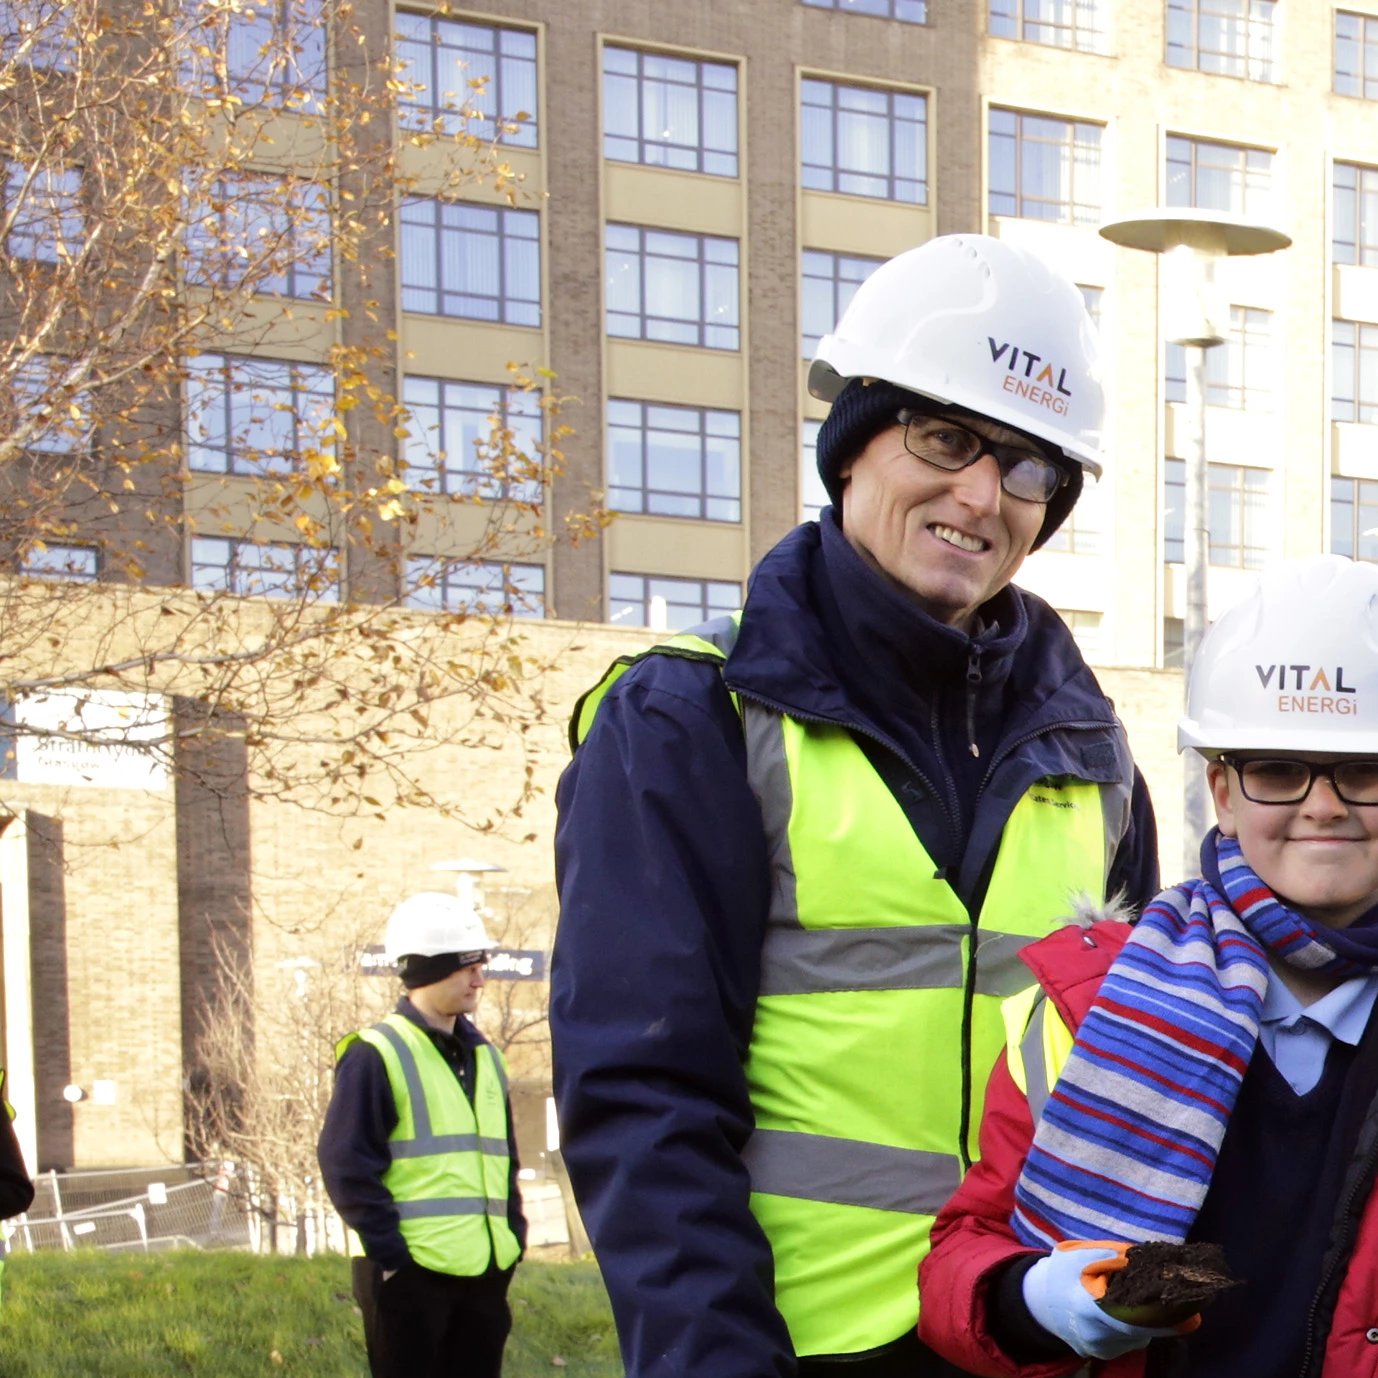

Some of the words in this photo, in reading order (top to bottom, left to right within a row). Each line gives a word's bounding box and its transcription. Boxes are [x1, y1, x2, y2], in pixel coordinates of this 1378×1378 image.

[988, 336, 1072, 397] VITAL
[1003, 375, 1070, 417] ENERGi
[1255, 664, 1356, 693] VITAL
[1278, 695, 1357, 715] ENERGi
